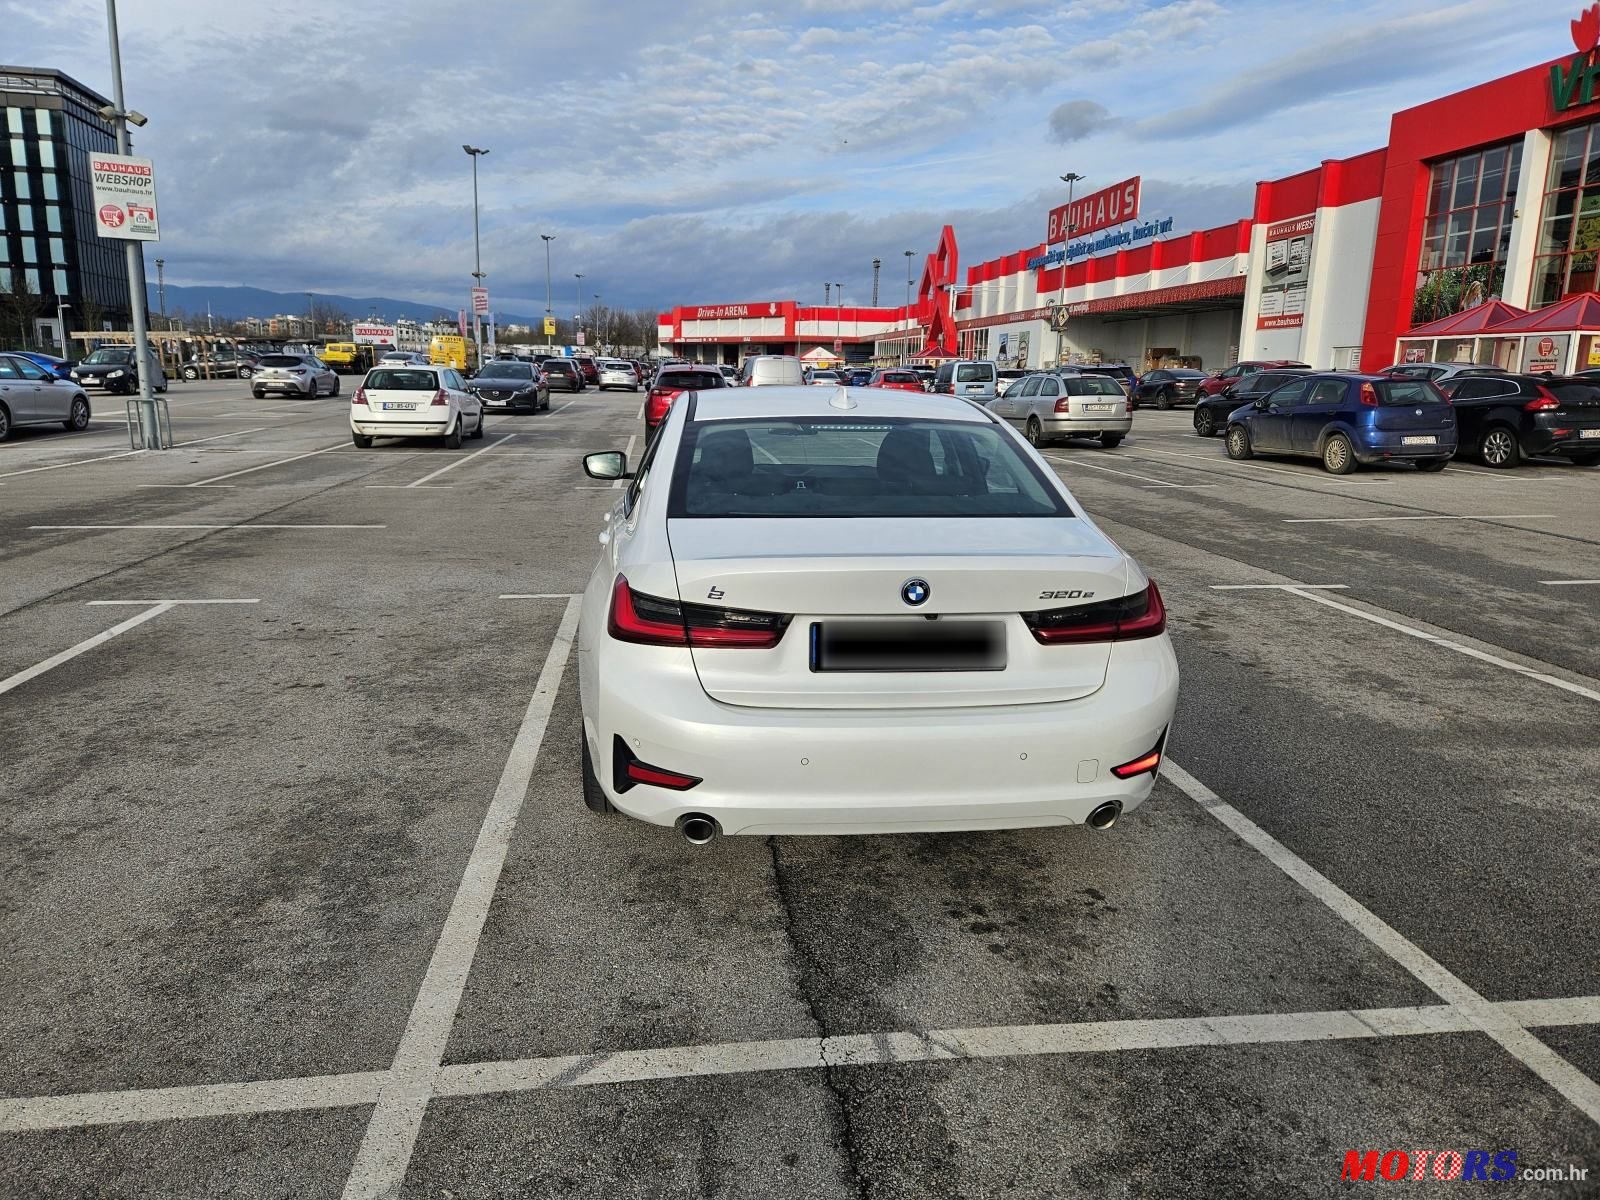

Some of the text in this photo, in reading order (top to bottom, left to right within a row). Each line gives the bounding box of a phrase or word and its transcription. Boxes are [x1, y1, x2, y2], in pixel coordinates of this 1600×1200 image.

[94, 162, 151, 175] BAUHAUS
[95, 172, 152, 187] WEBSHOP
[96, 185, 153, 195] www.bauhaus.hr
[1049, 184, 1135, 240] BAUHAUS
[1269, 224, 1296, 237] BAUHAUS
[697, 305, 748, 318] Drive-In ARENA
[355, 328, 393, 337] BAUHAUS
